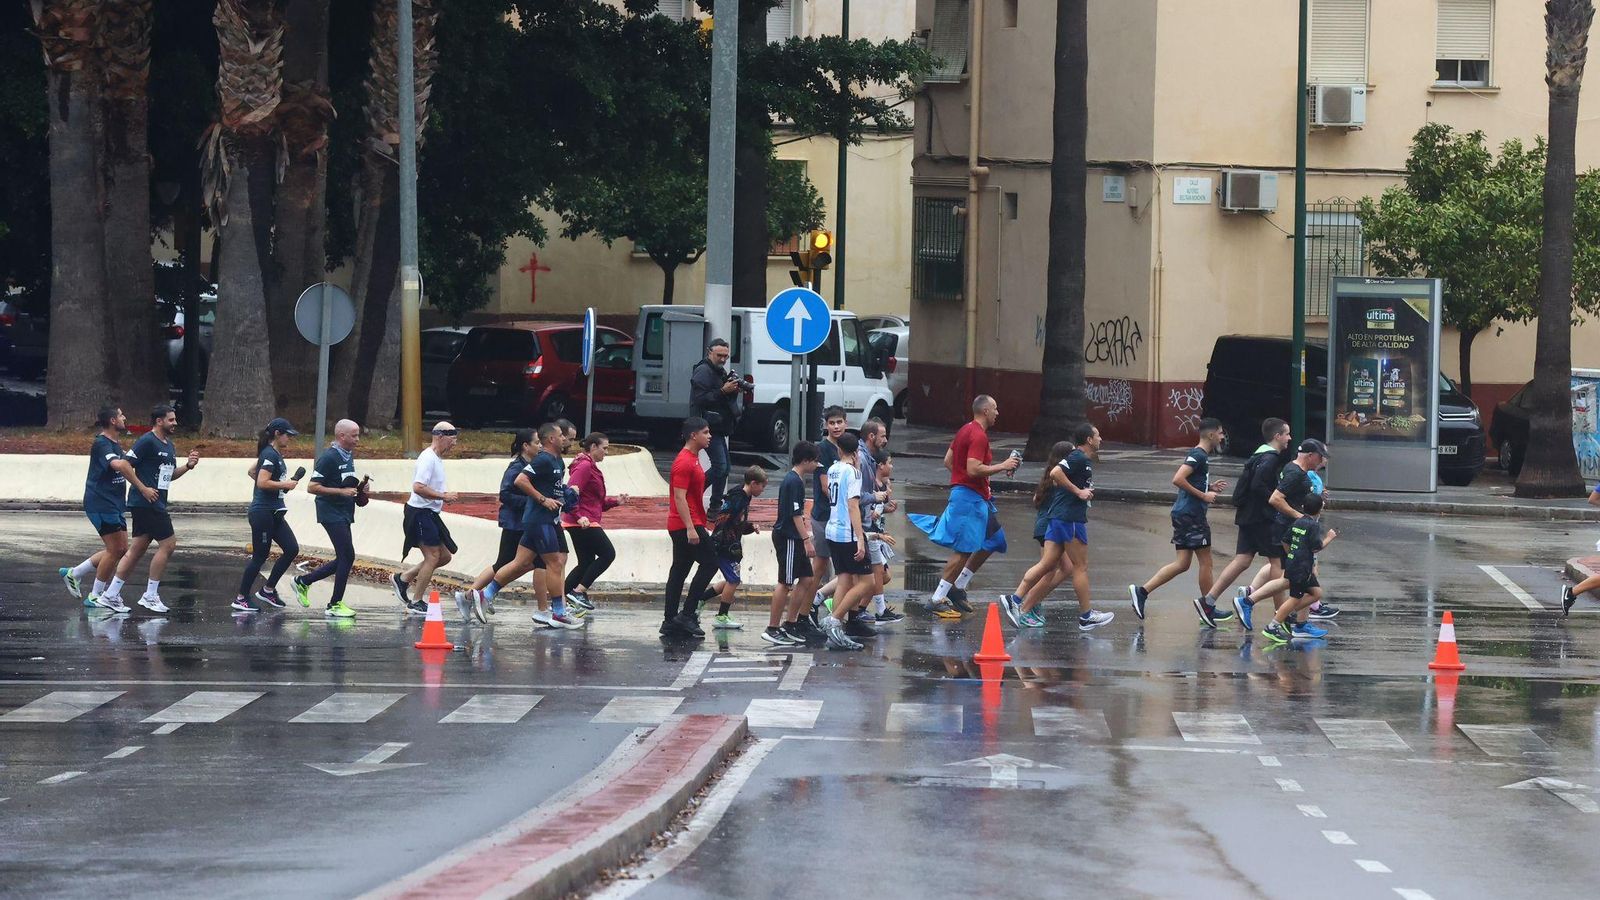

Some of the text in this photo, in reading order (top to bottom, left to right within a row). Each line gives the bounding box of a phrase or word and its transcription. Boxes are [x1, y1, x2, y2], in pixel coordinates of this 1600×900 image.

[1366, 310, 1395, 320] ultima
[1374, 333, 1415, 342] PROTEÍNAS
[1377, 341, 1410, 349] CALIDAD
[1353, 379, 1375, 387] ultima
[1383, 380, 1406, 388] ultima
